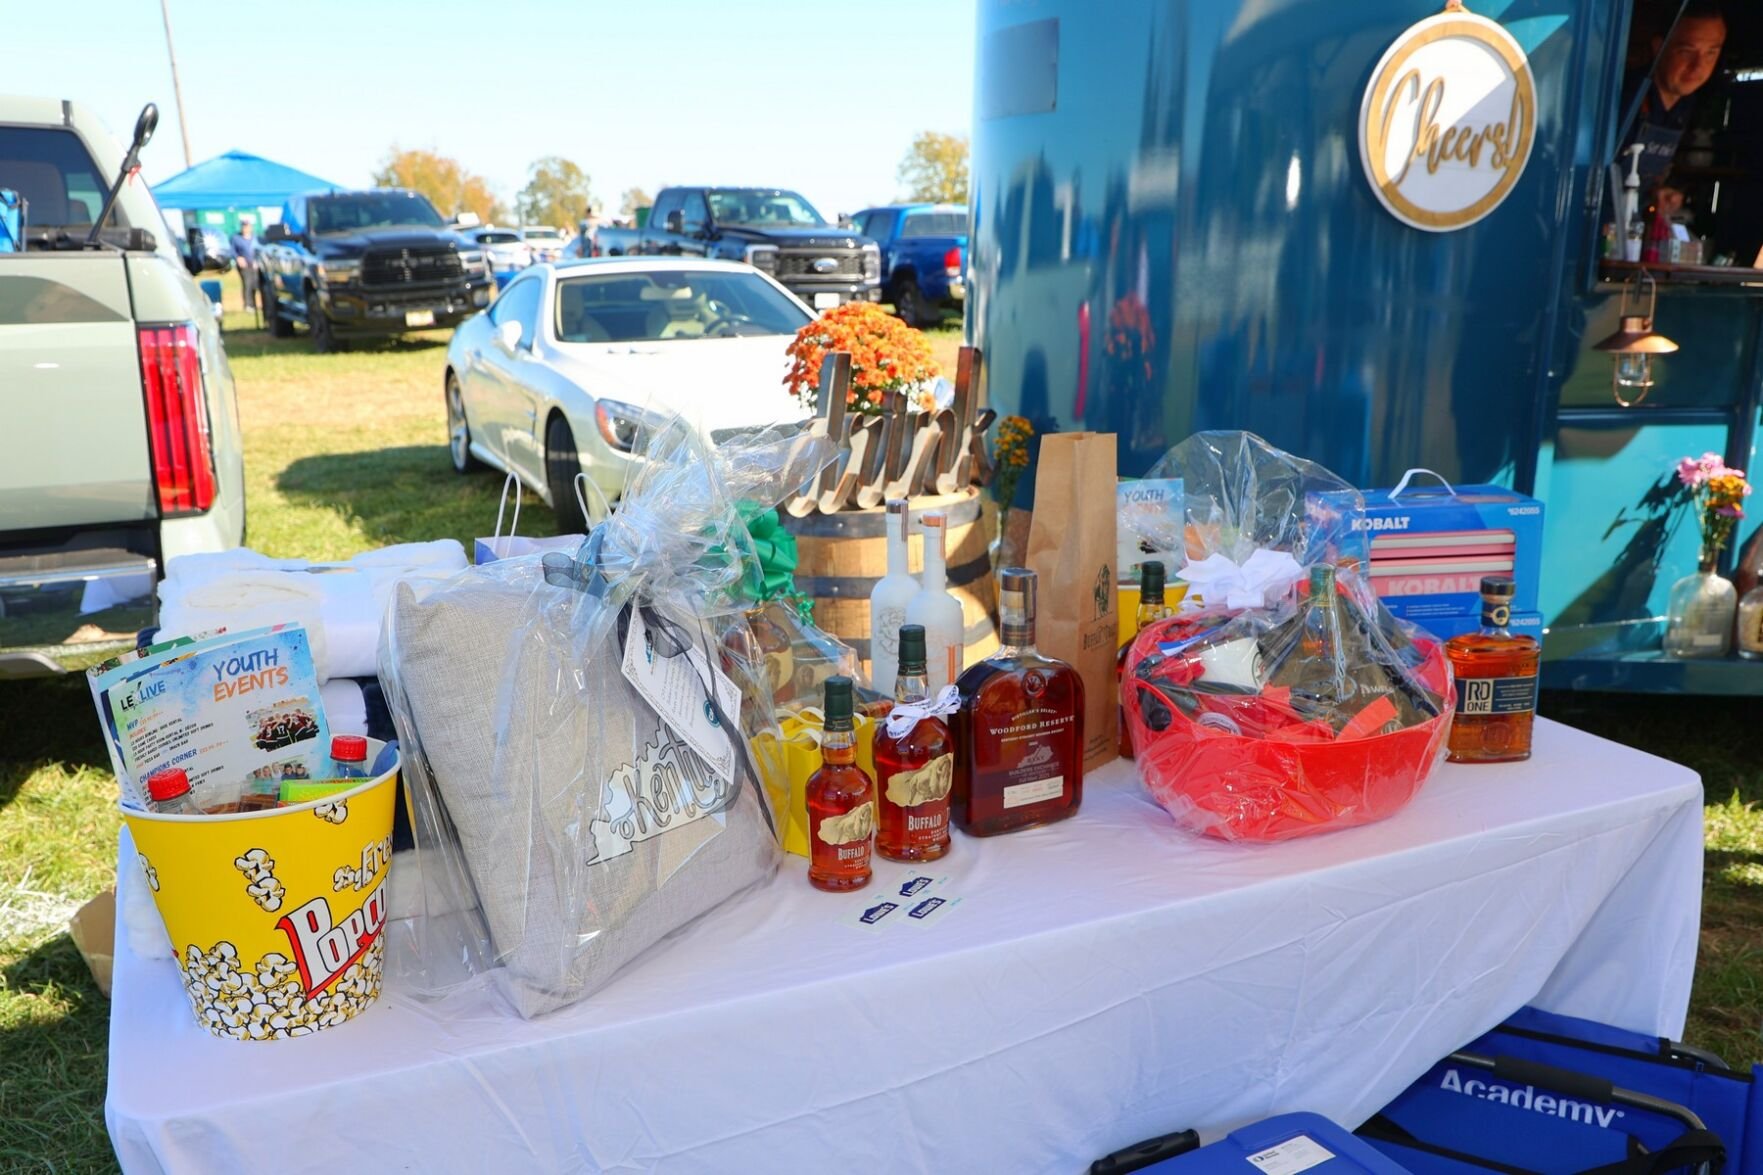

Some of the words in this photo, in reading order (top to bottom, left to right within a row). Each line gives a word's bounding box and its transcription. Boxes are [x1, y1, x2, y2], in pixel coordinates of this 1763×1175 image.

[1124, 488, 1165, 503] YOUTH
[1351, 516, 1411, 531] KOBALT
[1388, 574, 1484, 596] KOBALT
[212, 647, 280, 682] YOUTH
[213, 665, 289, 703] EVENTS
[1468, 681, 1491, 701] RD
[1466, 701, 1489, 712] ONE
[990, 723, 1037, 736] WOODFORD
[1040, 715, 1075, 728] RESERVE
[171, 748, 198, 765] CORNER
[908, 813, 942, 831] BUFFALO
[837, 845, 865, 861] BUFFALO
[1440, 1069, 1618, 1129] Academy
